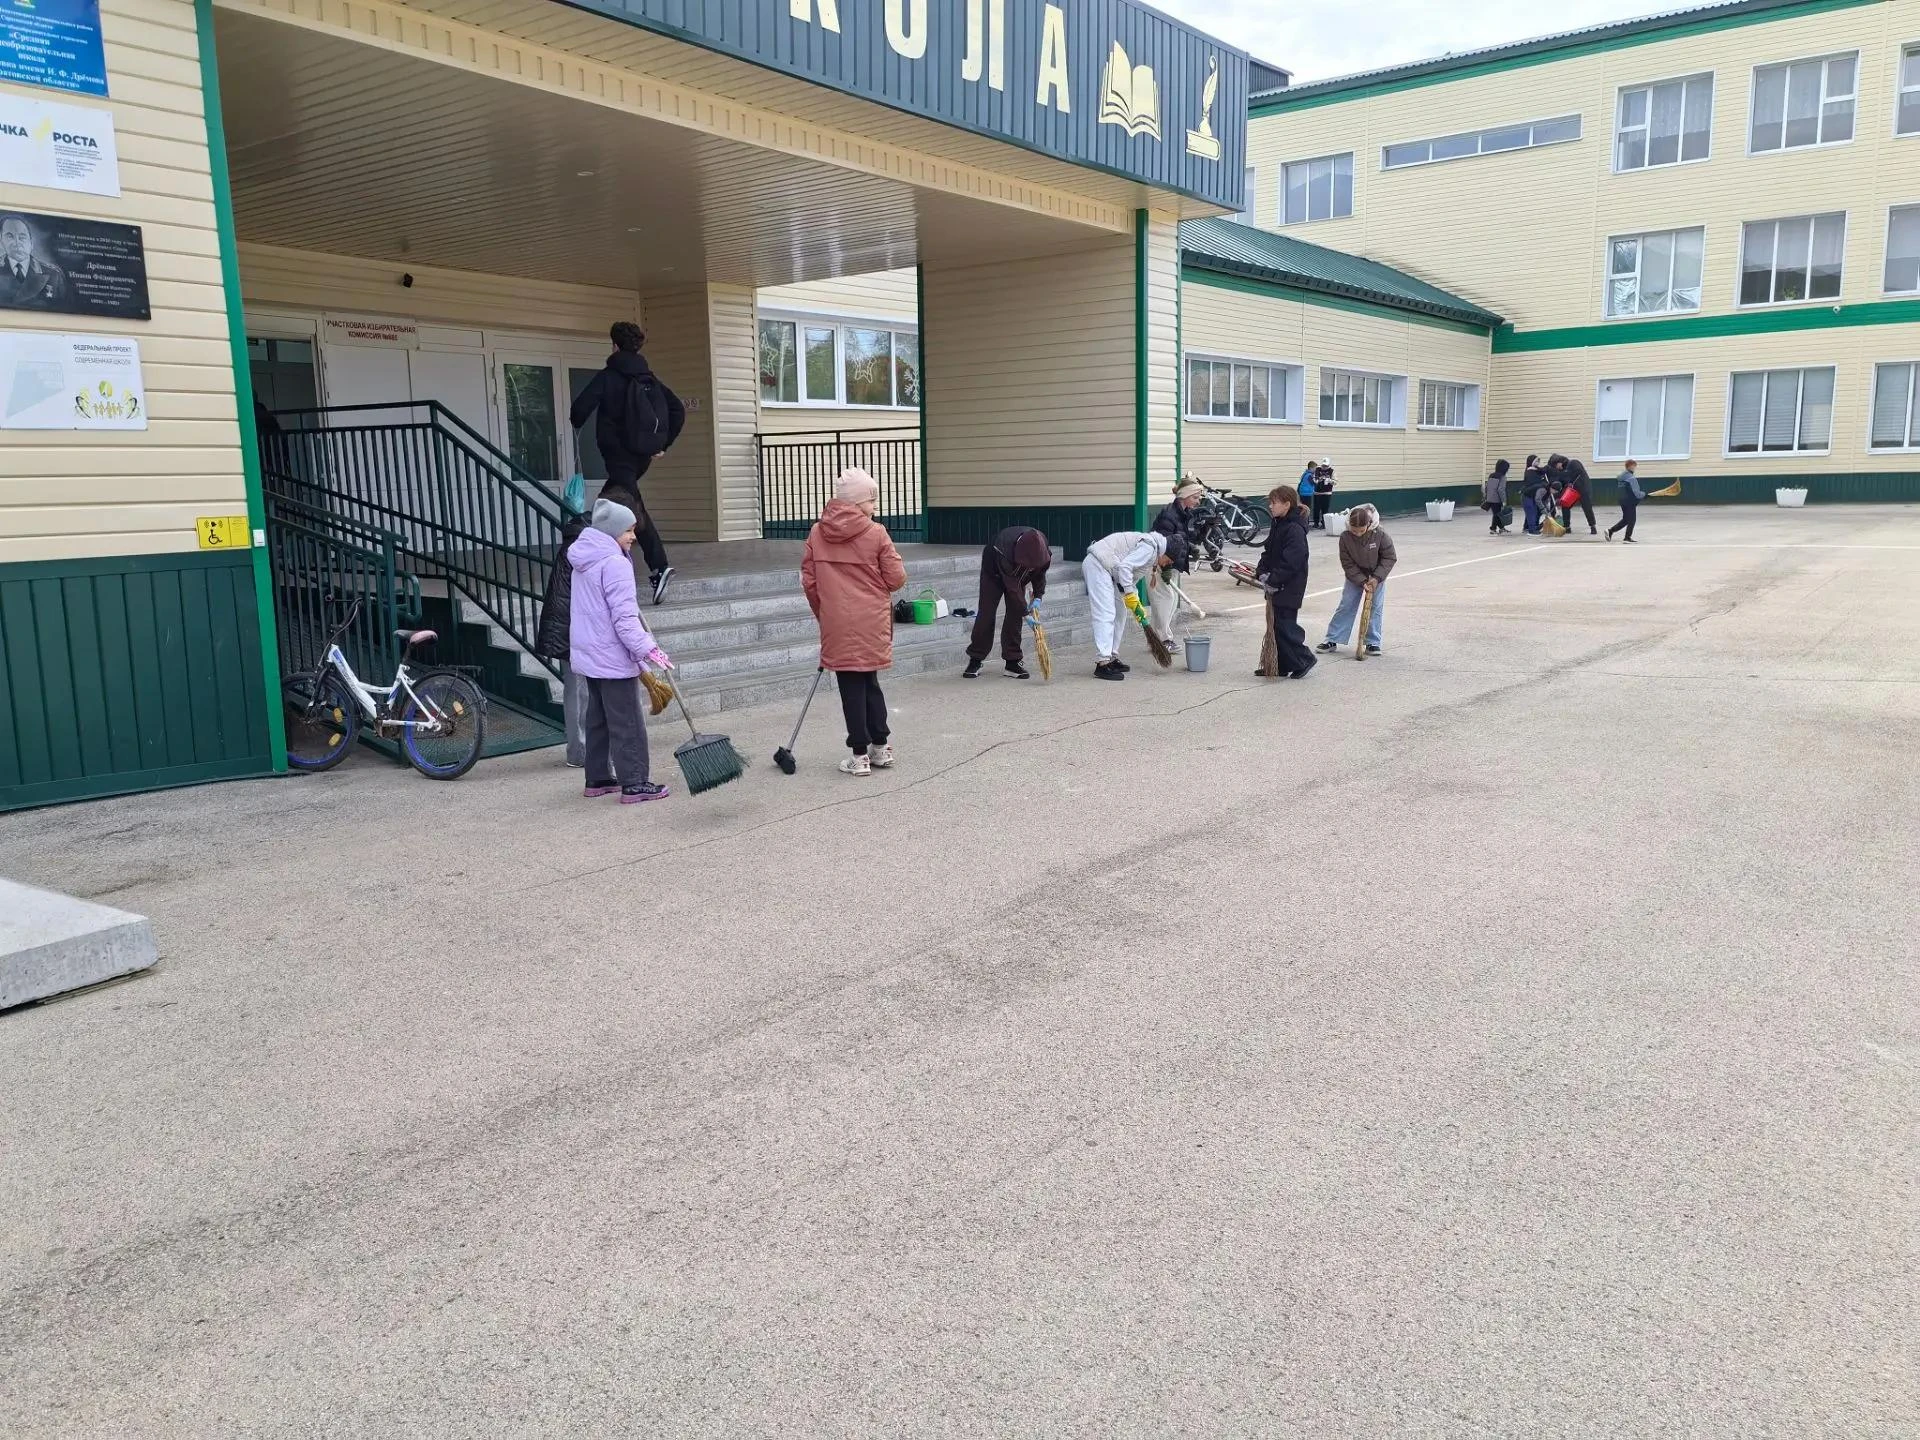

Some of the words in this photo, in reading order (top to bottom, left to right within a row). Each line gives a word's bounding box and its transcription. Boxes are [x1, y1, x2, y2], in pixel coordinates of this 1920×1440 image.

[53, 132, 98, 148] РОСТА
[326, 320, 366, 329] УЧАСТКОВАЯ
[367, 322, 416, 334] ИЗБИРАТЕЛЬНАЯ
[348, 331, 381, 339] КОМИССИЯ
[73, 344, 112, 352] ФЕДЕРАЛЬНЫЙ
